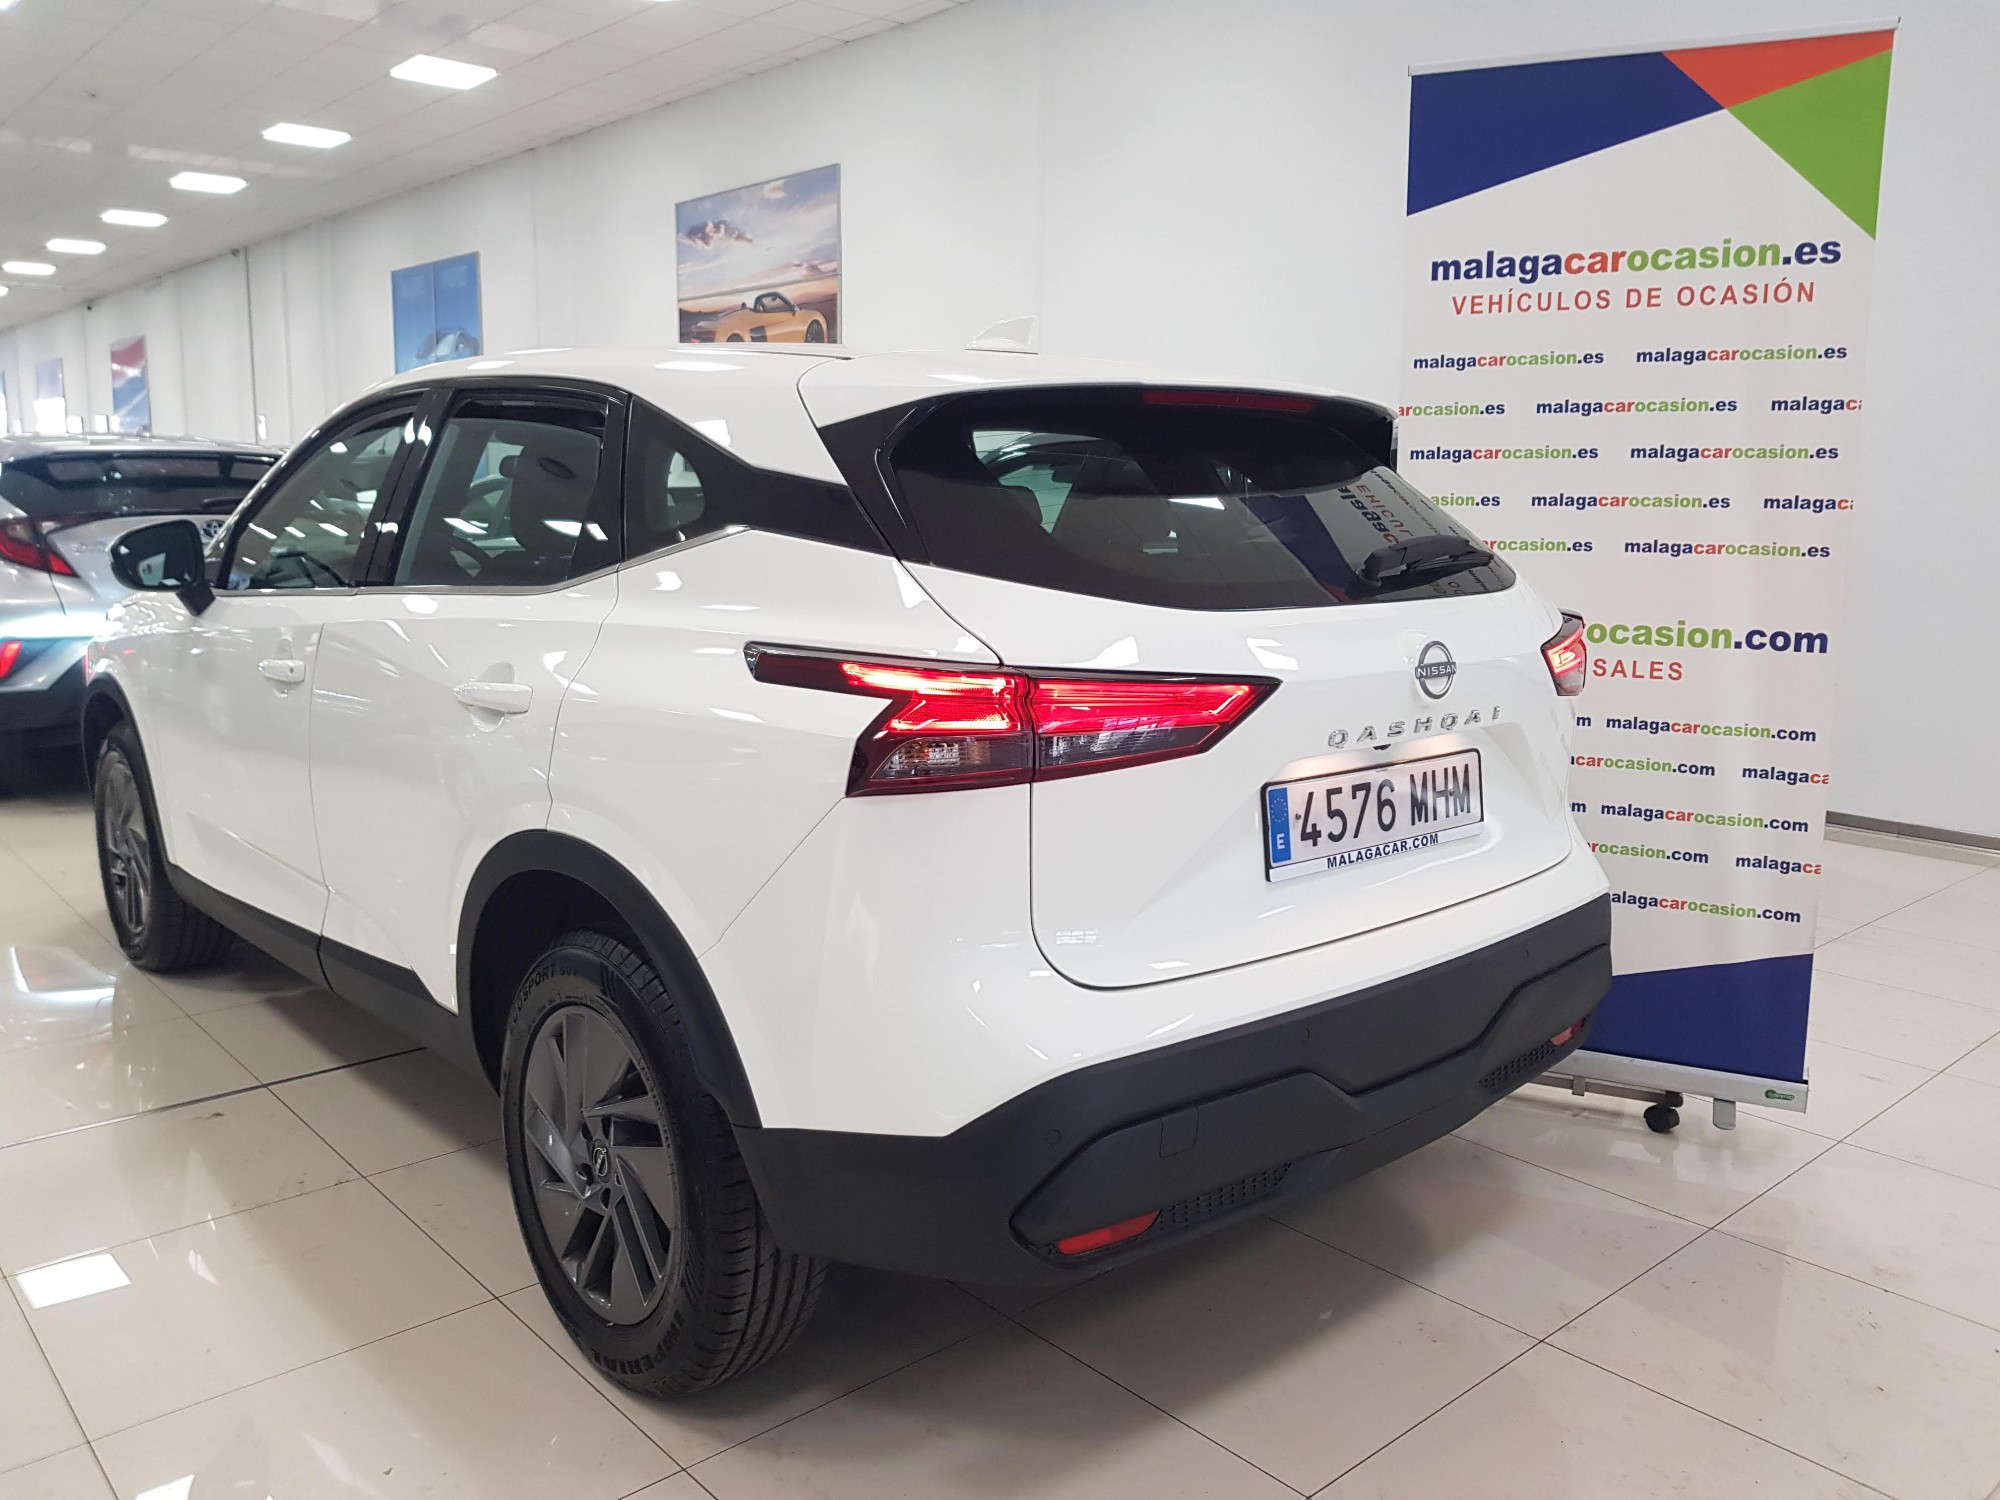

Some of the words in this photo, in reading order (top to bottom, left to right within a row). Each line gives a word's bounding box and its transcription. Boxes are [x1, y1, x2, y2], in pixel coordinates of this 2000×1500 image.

[1431, 239, 1842, 284] malagacarocasion.es
[1452, 287, 1611, 315] VEHÍCULOS
[1626, 287, 1662, 309] DE
[1676, 277, 1816, 307] OCASIÓN
[1413, 350, 1604, 371] malagacarocasion.es
[1636, 344, 1847, 366] malagacarocasion.es
[1536, 397, 1738, 416] malagacarocasion.es
[1410, 445, 1599, 463] malagacarocasion.es
[1630, 444, 1839, 463] malagacarocasion.es
[1531, 492, 1731, 511] malagacarocasion.es
[1624, 539, 1831, 558] malagacarocasion.es
[1584, 620, 1829, 654] ocasion.com
[1417, 663, 1457, 678] NISSAN
[1592, 658, 1684, 682] SALES
[1328, 705, 1501, 749] QASHQAI
[1606, 714, 1817, 742] malagacarocasion.com
[1300, 778, 1396, 848] 4576
[1410, 763, 1472, 827] MHM
[1601, 802, 1809, 833] malagacarocasion.com
[1276, 832, 1286, 850] E
[1326, 832, 1440, 870] MALAGACAR.COM
